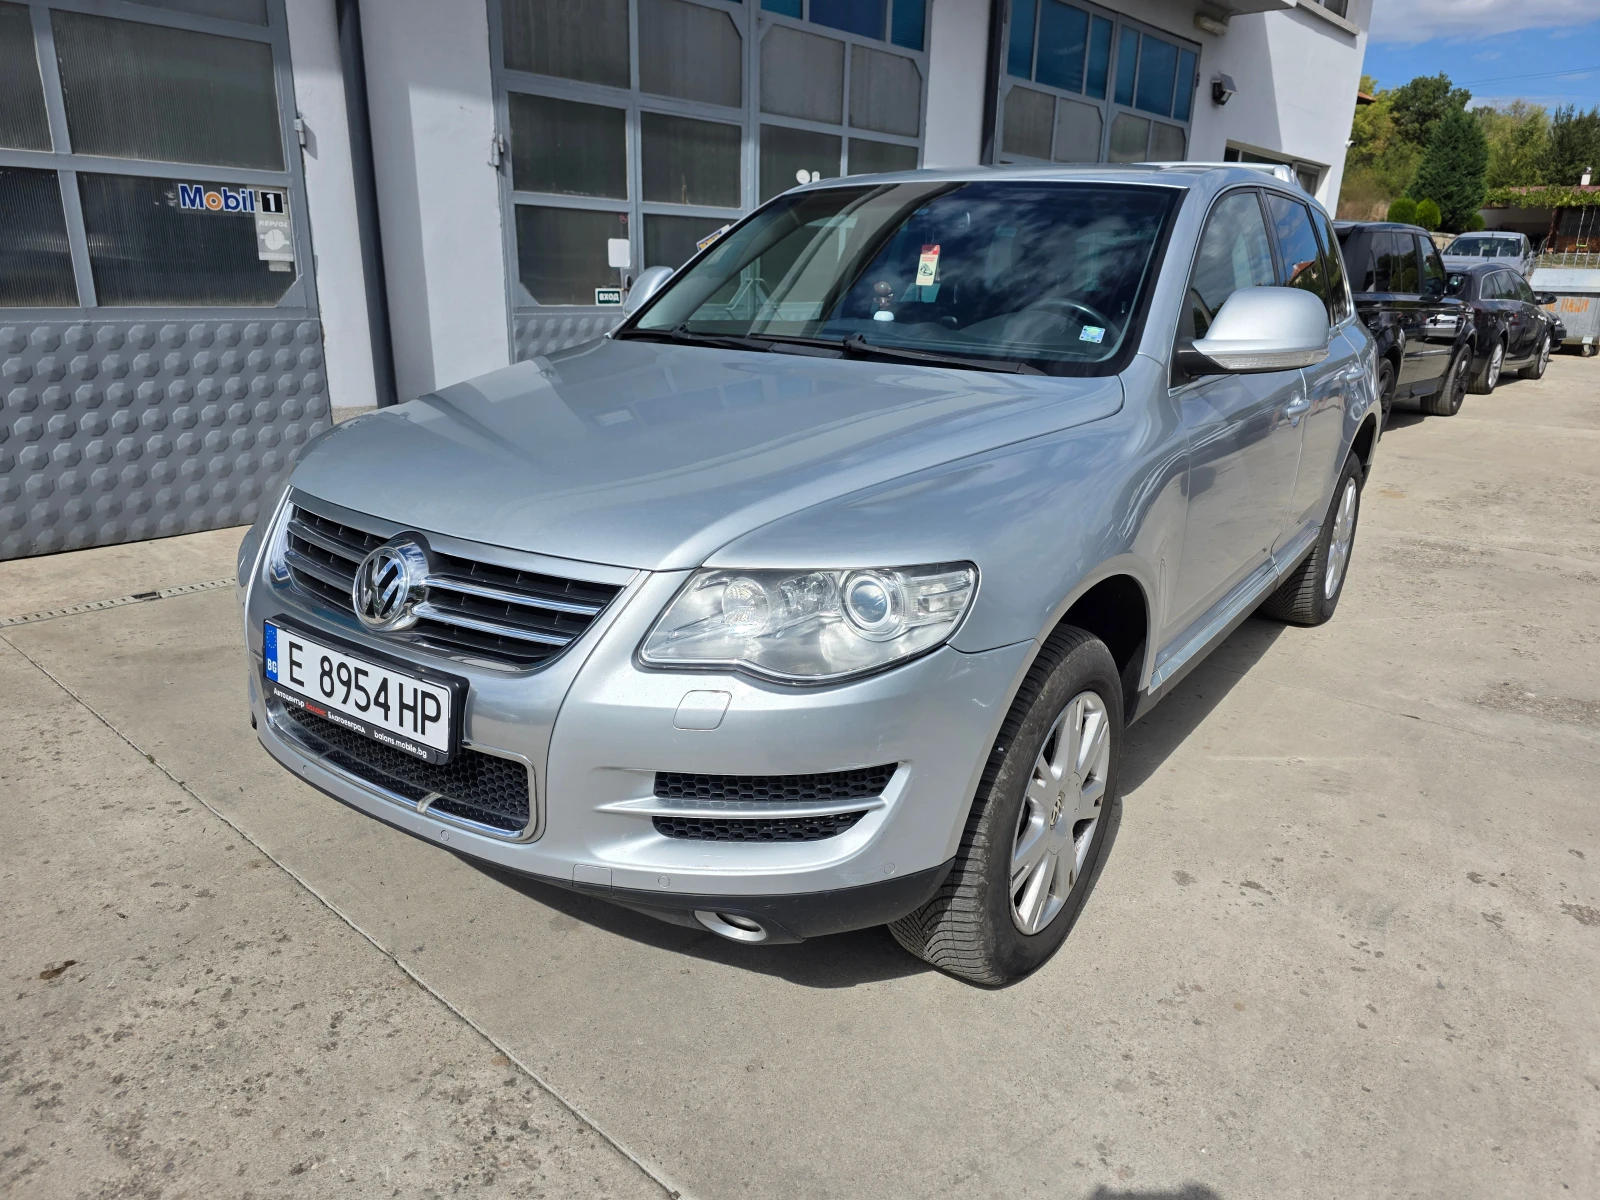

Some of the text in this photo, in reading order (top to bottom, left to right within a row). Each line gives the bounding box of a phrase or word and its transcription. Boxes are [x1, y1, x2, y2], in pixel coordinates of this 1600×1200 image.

[179, 184, 278, 213] Mobil 1
[258, 220, 288, 228] REPSOL
[598, 293, 619, 301] ВХОД
[267, 658, 277, 673] BG
[288, 640, 442, 736] E 8954 HP
[273, 687, 305, 708] Автоцентър
[327, 711, 366, 733] Благоевград
[374, 730, 428, 759] balans.mobile.bg
